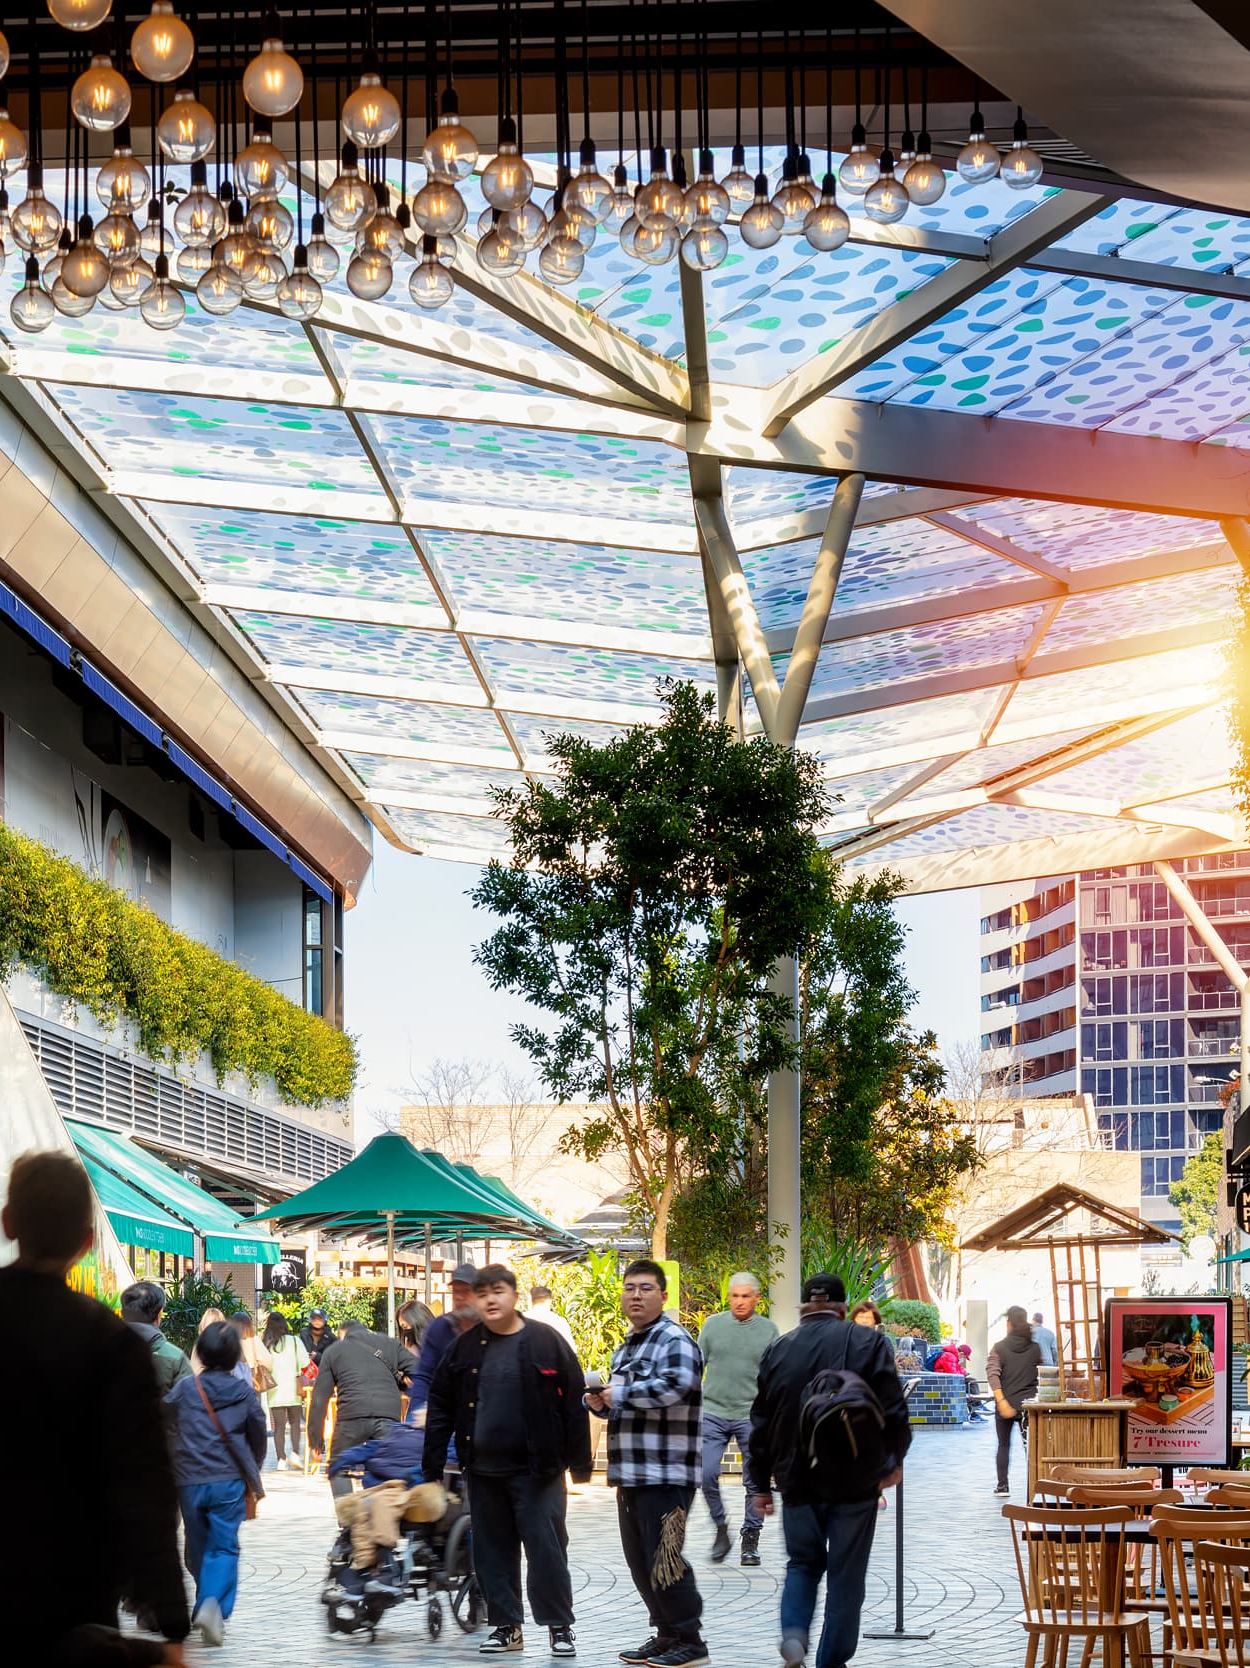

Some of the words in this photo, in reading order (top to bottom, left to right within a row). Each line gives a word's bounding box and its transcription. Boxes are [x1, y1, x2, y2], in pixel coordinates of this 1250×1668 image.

[1130, 1427, 1144, 1435] Try
[1159, 1427, 1186, 1435] dessert
[1133, 1436, 1143, 1448] 7
[1144, 1435, 1202, 1448] Tresure
